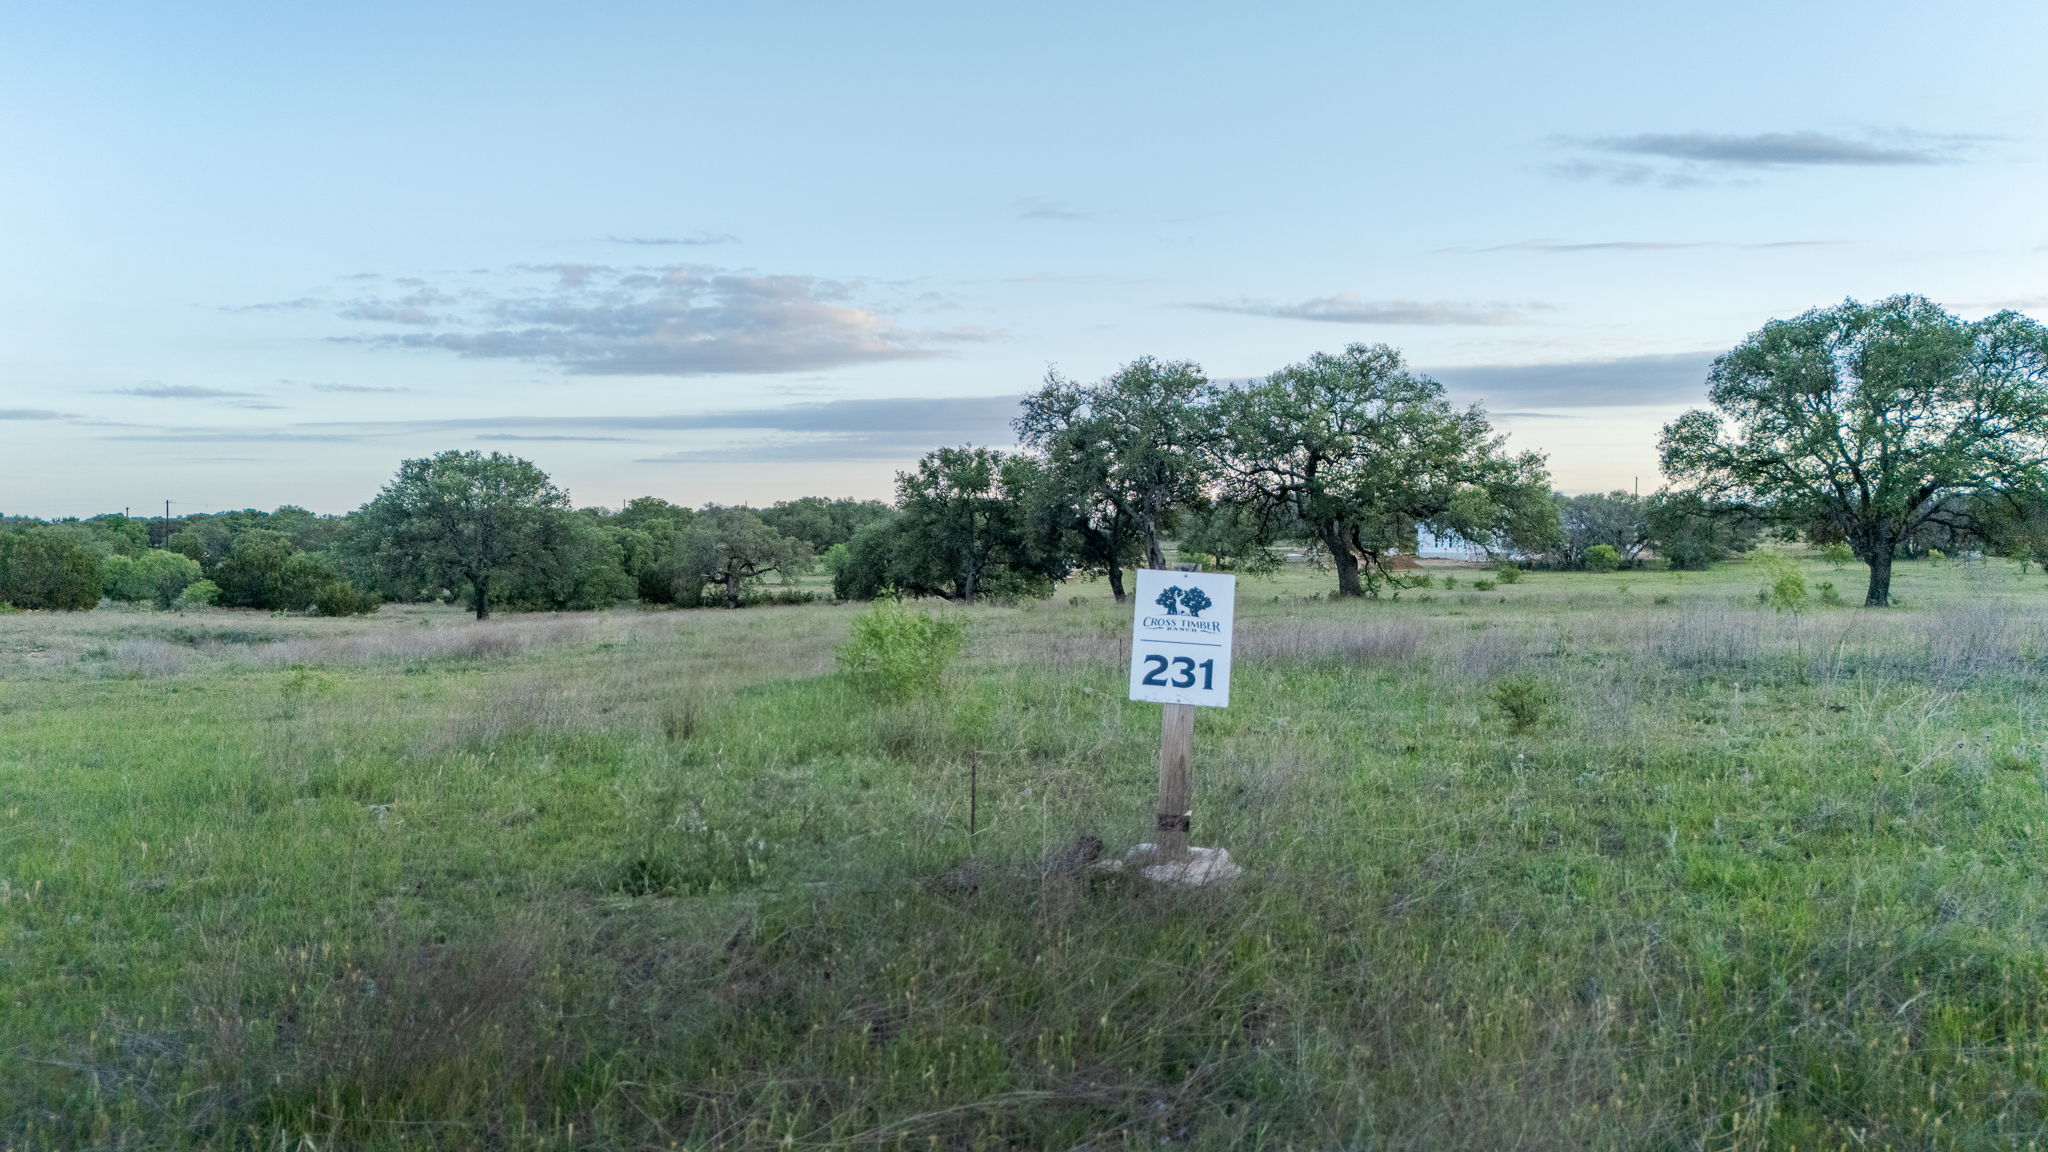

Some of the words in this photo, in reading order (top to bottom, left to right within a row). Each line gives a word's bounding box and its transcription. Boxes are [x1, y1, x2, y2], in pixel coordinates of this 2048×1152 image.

[1143, 616, 1177, 627] CROSS
[1182, 620, 1221, 632] TIMBER
[1142, 654, 1214, 690] 231
